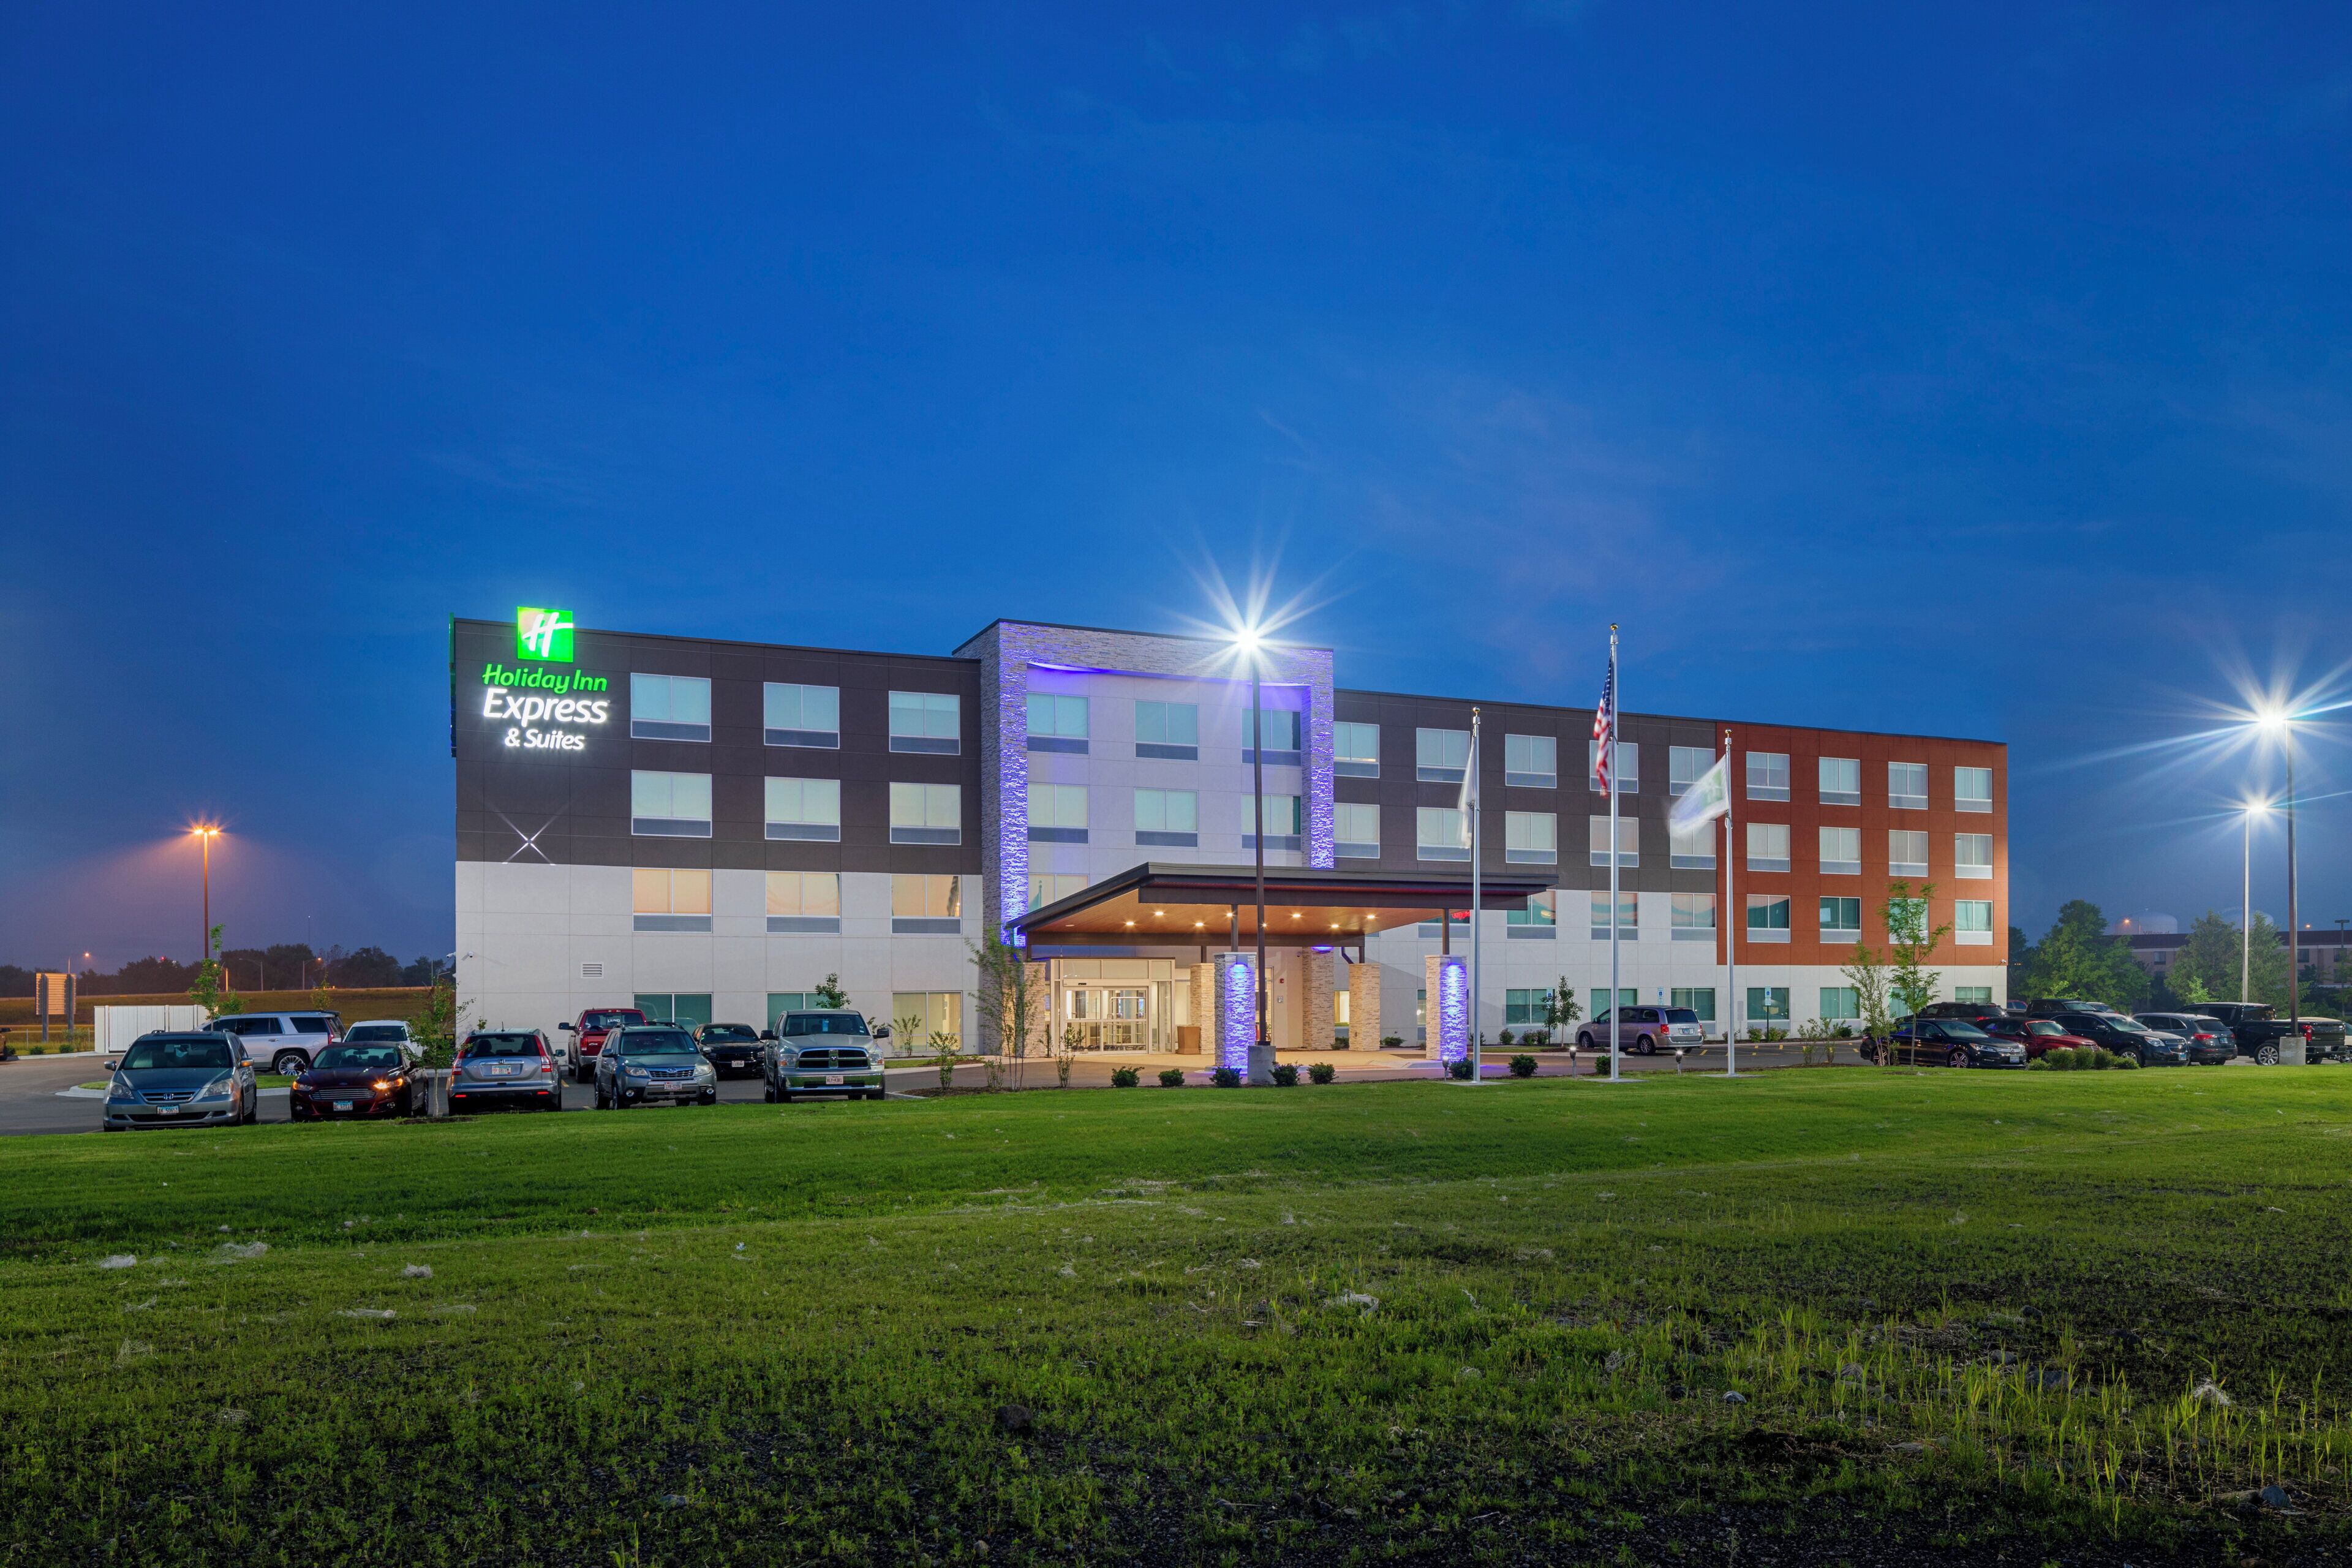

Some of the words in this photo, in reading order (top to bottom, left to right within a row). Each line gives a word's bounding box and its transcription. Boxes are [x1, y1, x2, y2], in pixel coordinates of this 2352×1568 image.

[482, 663, 570, 695] Holiday
[572, 669, 608, 692] Inn
[483, 687, 608, 728] Express
[504, 727, 521, 747] &
[523, 729, 585, 750] Suites
